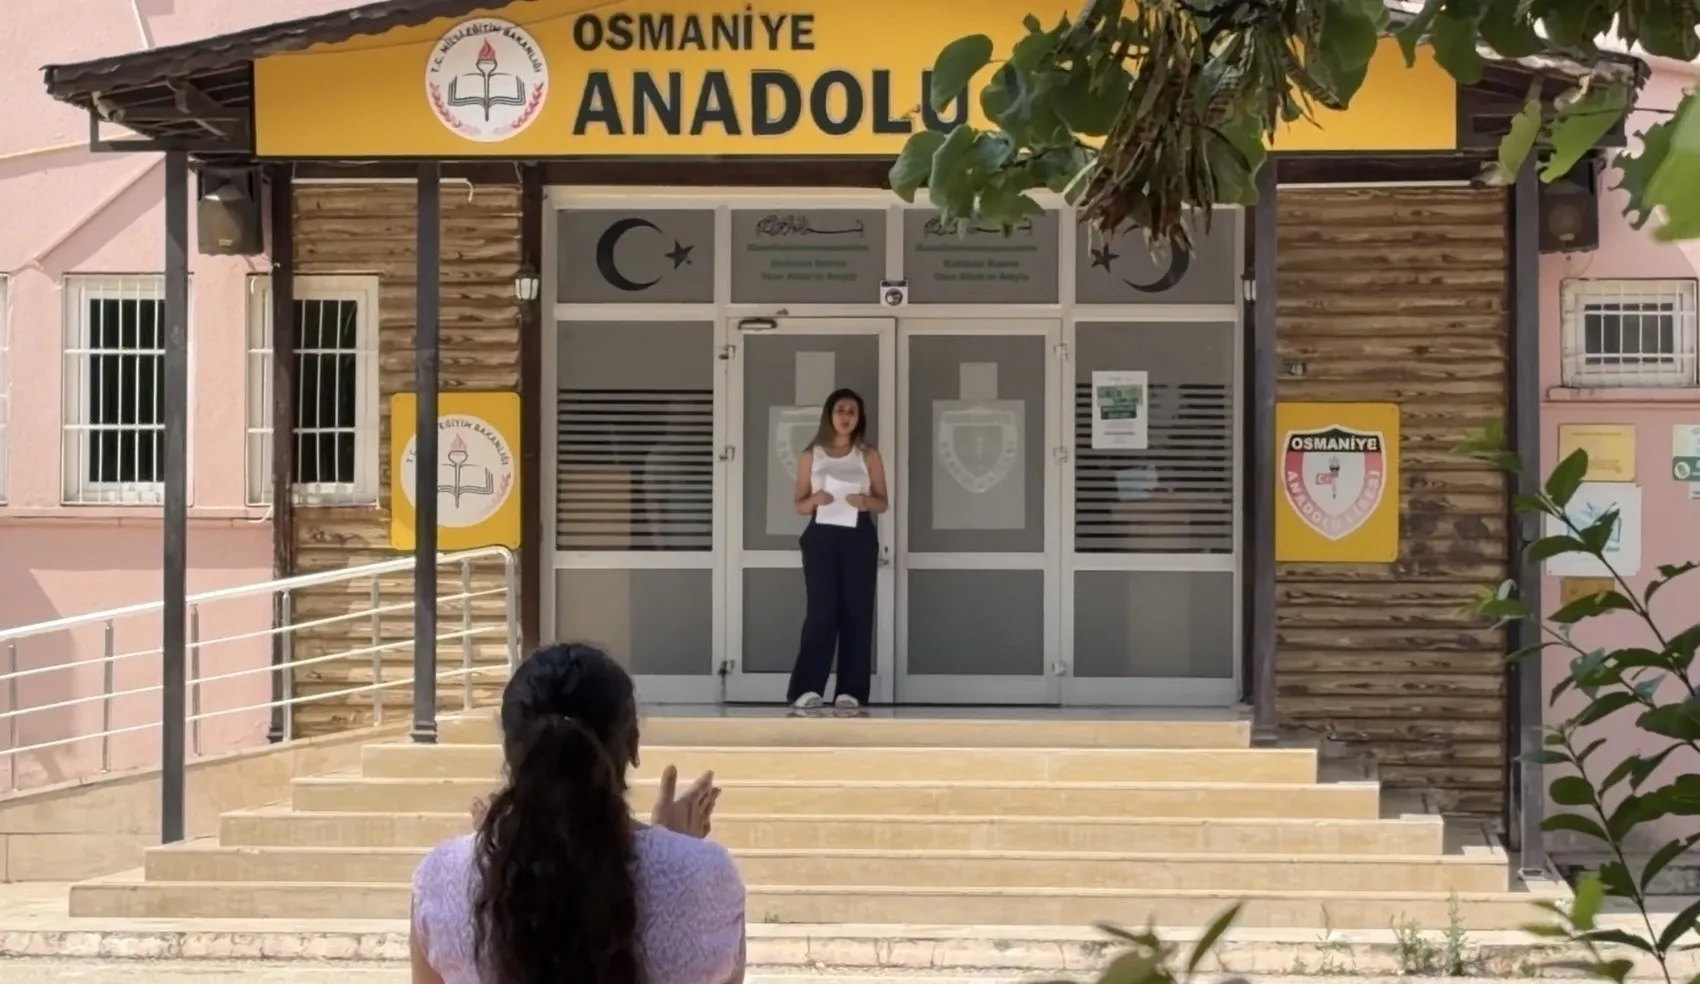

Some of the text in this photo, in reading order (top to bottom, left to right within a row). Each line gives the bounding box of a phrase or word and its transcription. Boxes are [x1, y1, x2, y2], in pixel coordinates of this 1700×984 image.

[573, 6, 815, 51] OSMANİYE
[571, 68, 969, 136] ANADOLU
[1291, 435, 1379, 451] OSMANİYE
[1287, 470, 1341, 532] ANADOLU
